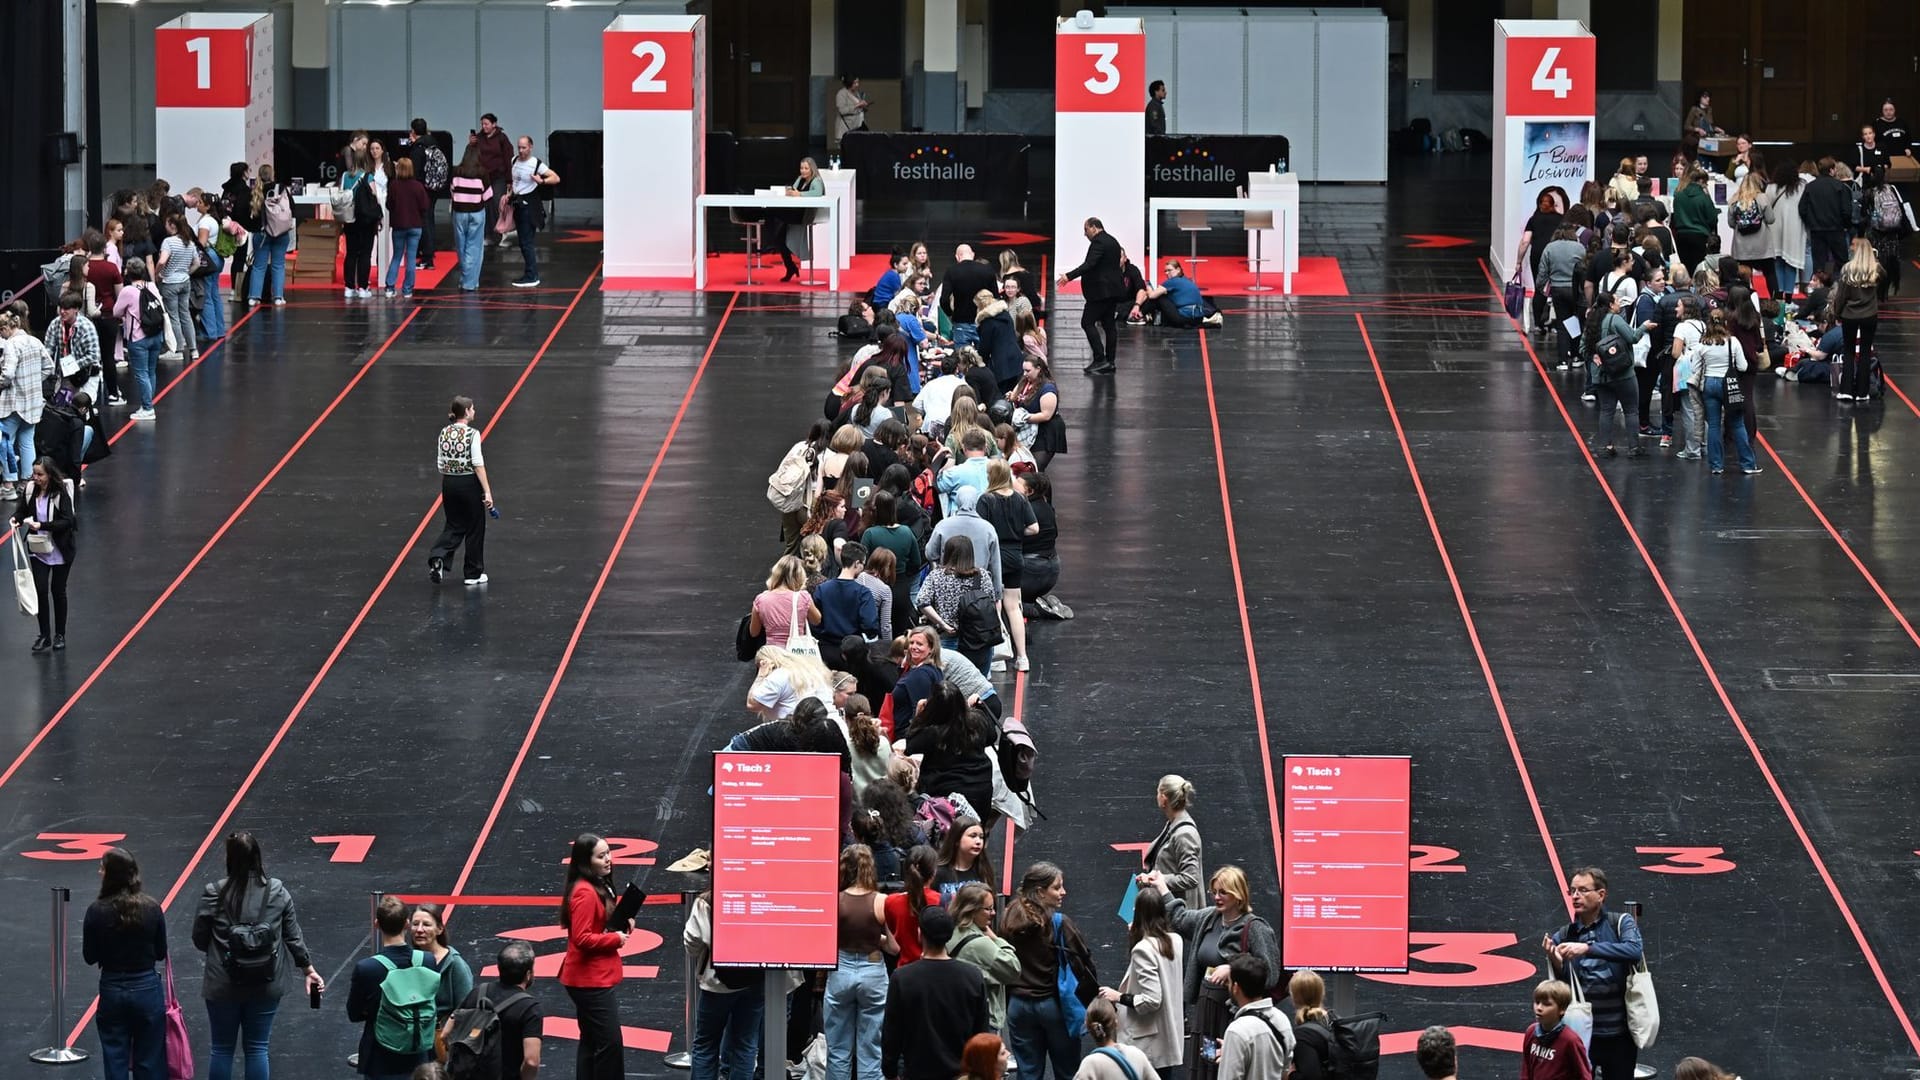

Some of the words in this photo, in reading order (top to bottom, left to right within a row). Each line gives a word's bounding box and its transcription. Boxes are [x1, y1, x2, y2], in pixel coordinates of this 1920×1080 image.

[186, 37, 210, 89] 1
[631, 41, 667, 93] 2
[1083, 42, 1120, 95] 3
[1531, 47, 1572, 98] 4
[893, 162, 975, 180] festhalle
[1153, 164, 1236, 182] festhalle
[1523, 151, 1585, 184] Iosivoni
[736, 763, 762, 773] Tisch
[764, 763, 771, 773] 2
[1306, 767, 1332, 776] Tisch
[1334, 767, 1341, 776] 3
[20, 833, 126, 860] 3
[311, 835, 376, 863] 1
[1634, 846, 1737, 874] 3
[1355, 932, 1537, 987] 3
[1530, 1043, 1557, 1060] PARIS
